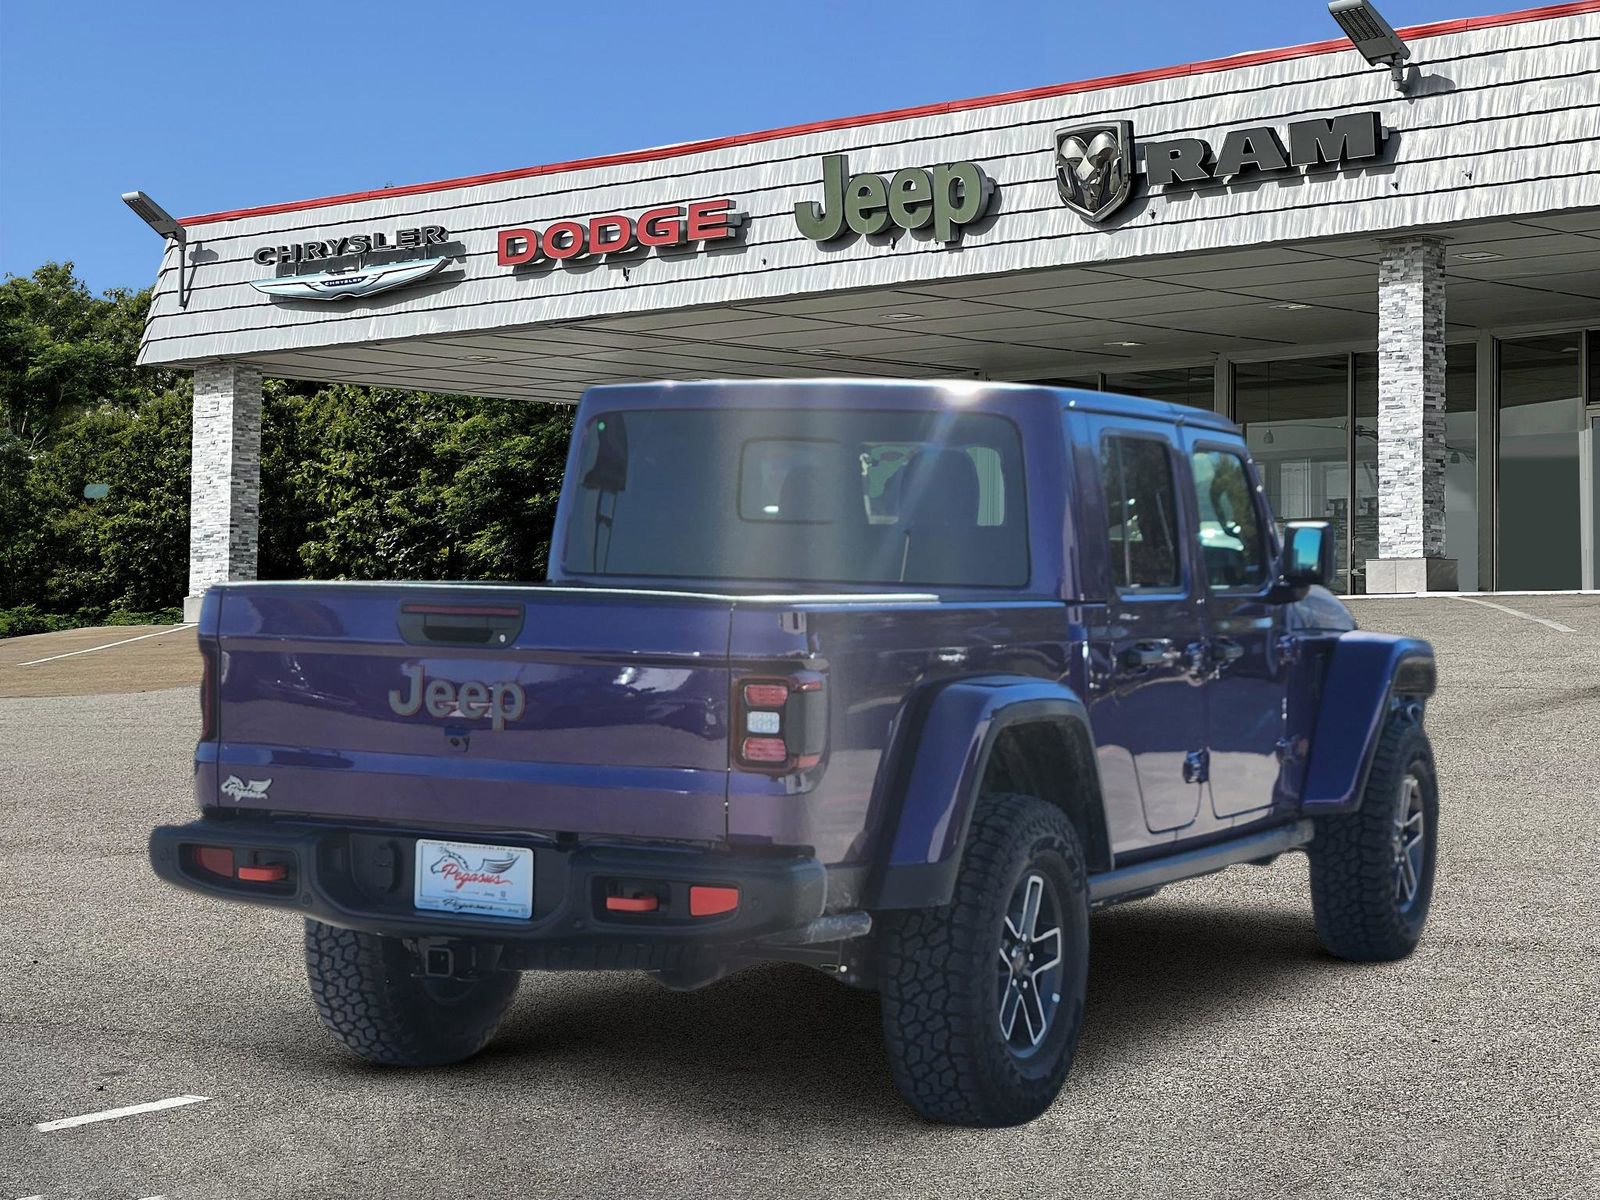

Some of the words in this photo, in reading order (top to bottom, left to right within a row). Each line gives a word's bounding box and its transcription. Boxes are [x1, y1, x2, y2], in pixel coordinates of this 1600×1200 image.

[1145, 111, 1382, 187] RAM
[794, 154, 990, 243] Jeep
[253, 225, 449, 266] CHRYSLER
[497, 199, 736, 266] DODGE
[324, 277, 363, 287] CHRYSLER
[388, 664, 527, 731] Jeep
[441, 862, 513, 890] Pegasus
